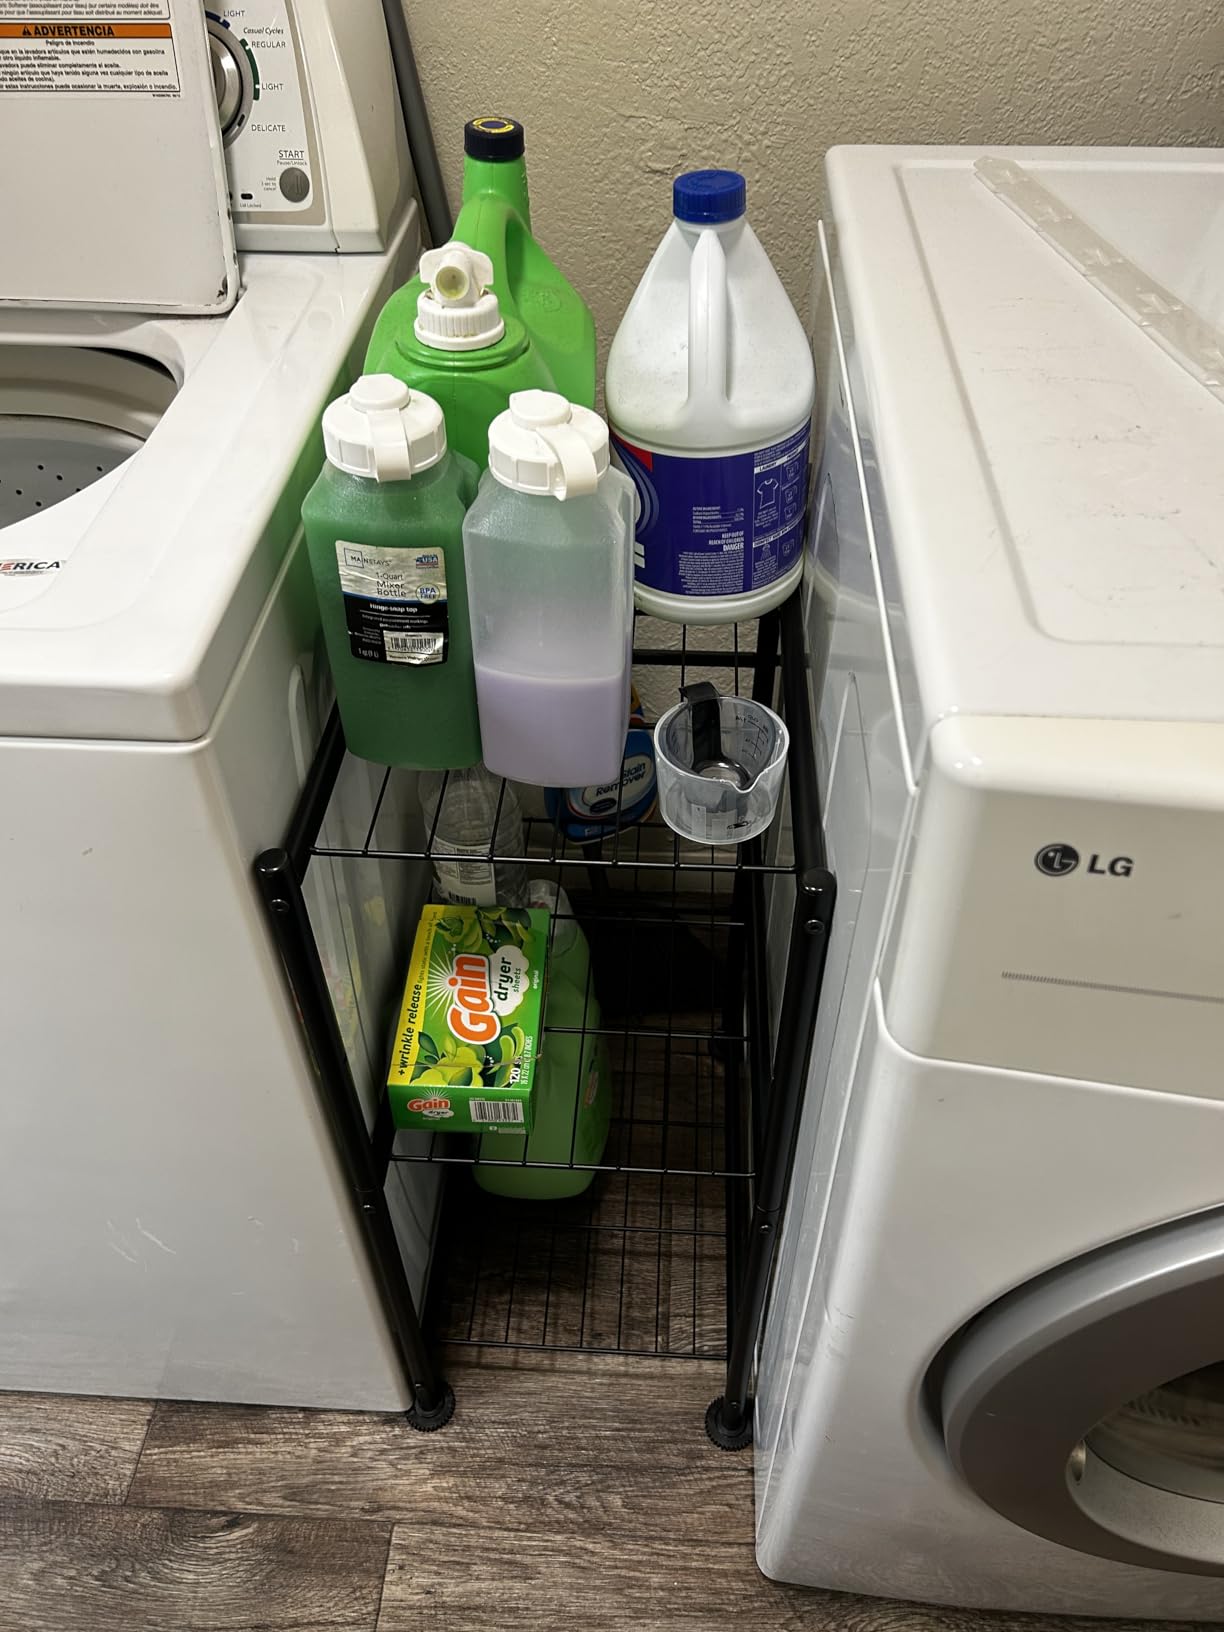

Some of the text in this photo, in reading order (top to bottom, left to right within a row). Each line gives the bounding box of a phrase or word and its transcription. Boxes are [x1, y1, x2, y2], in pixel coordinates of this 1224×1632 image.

[34, 26, 114, 36] ADVERTENCIA
[265, 27, 284, 36] Cycles
[279, 150, 304, 158] START
[723, 542, 744, 551] DANGER
[0, 561, 60, 570] ERICA
[376, 572, 404, 580] 1-Quart
[376, 580, 404, 589] Mixer
[377, 588, 407, 597] Bottle
[370, 603, 405, 612] Hinge-snap
[1087, 854, 1134, 878] LG
[494, 957, 513, 1001] dryer
[512, 968, 521, 992] sheets
[448, 954, 500, 1043] Gain
[398, 984, 422, 1076] +wrinkle release
[510, 1067, 521, 1084] 120
[408, 1098, 450, 1112] Gain
